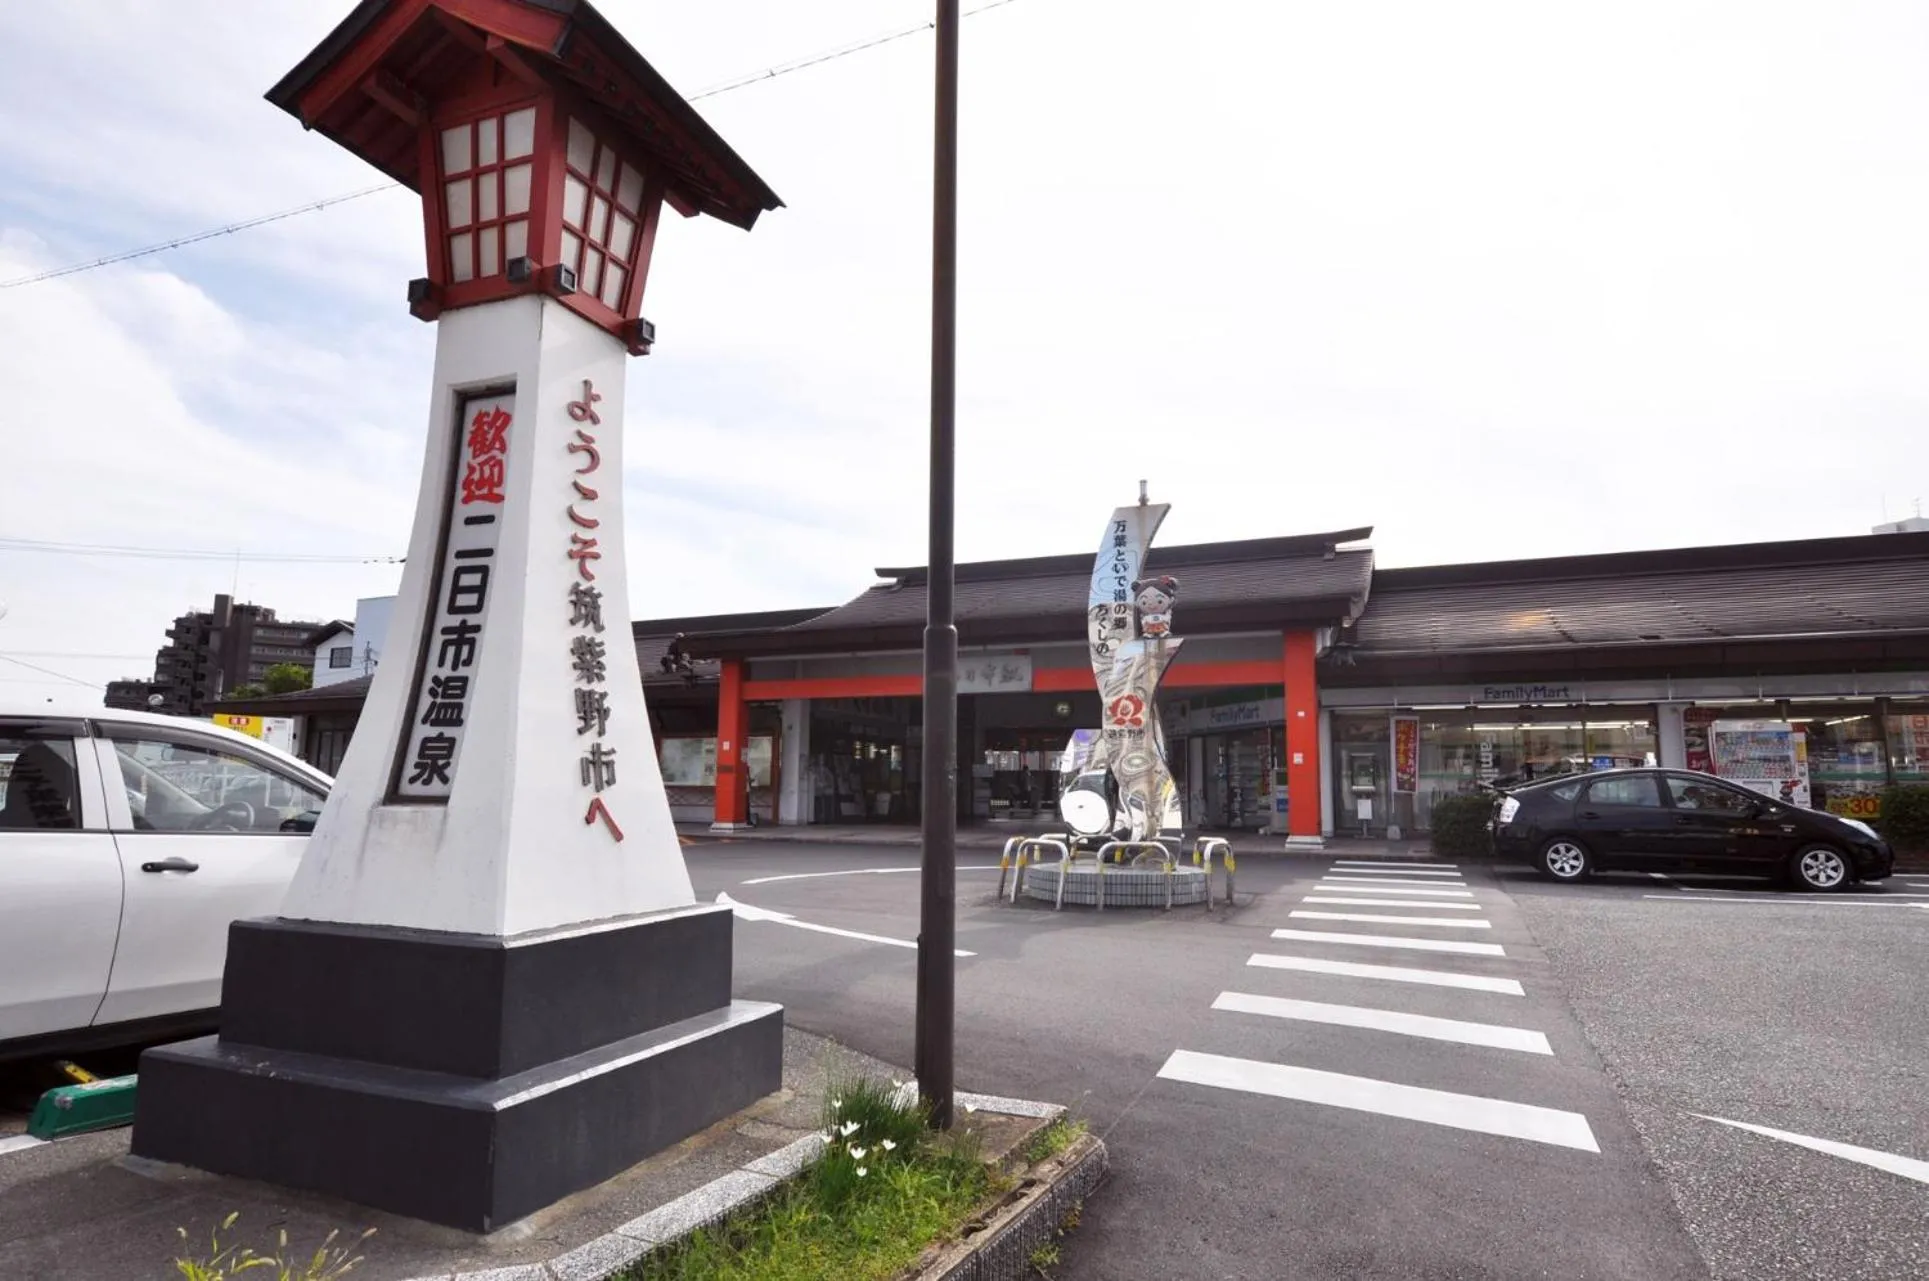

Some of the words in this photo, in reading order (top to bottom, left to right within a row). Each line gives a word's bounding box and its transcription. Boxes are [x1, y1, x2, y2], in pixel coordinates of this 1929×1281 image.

[1112, 520, 1130, 631] 万葉といで湯の郷
[566, 378, 624, 843] ようこそ筑紫野市へ
[1095, 604, 1110, 655] ちくしの
[1210, 704, 1260, 723] FamilyMart
[1483, 685, 1569, 701] FamilyMart
